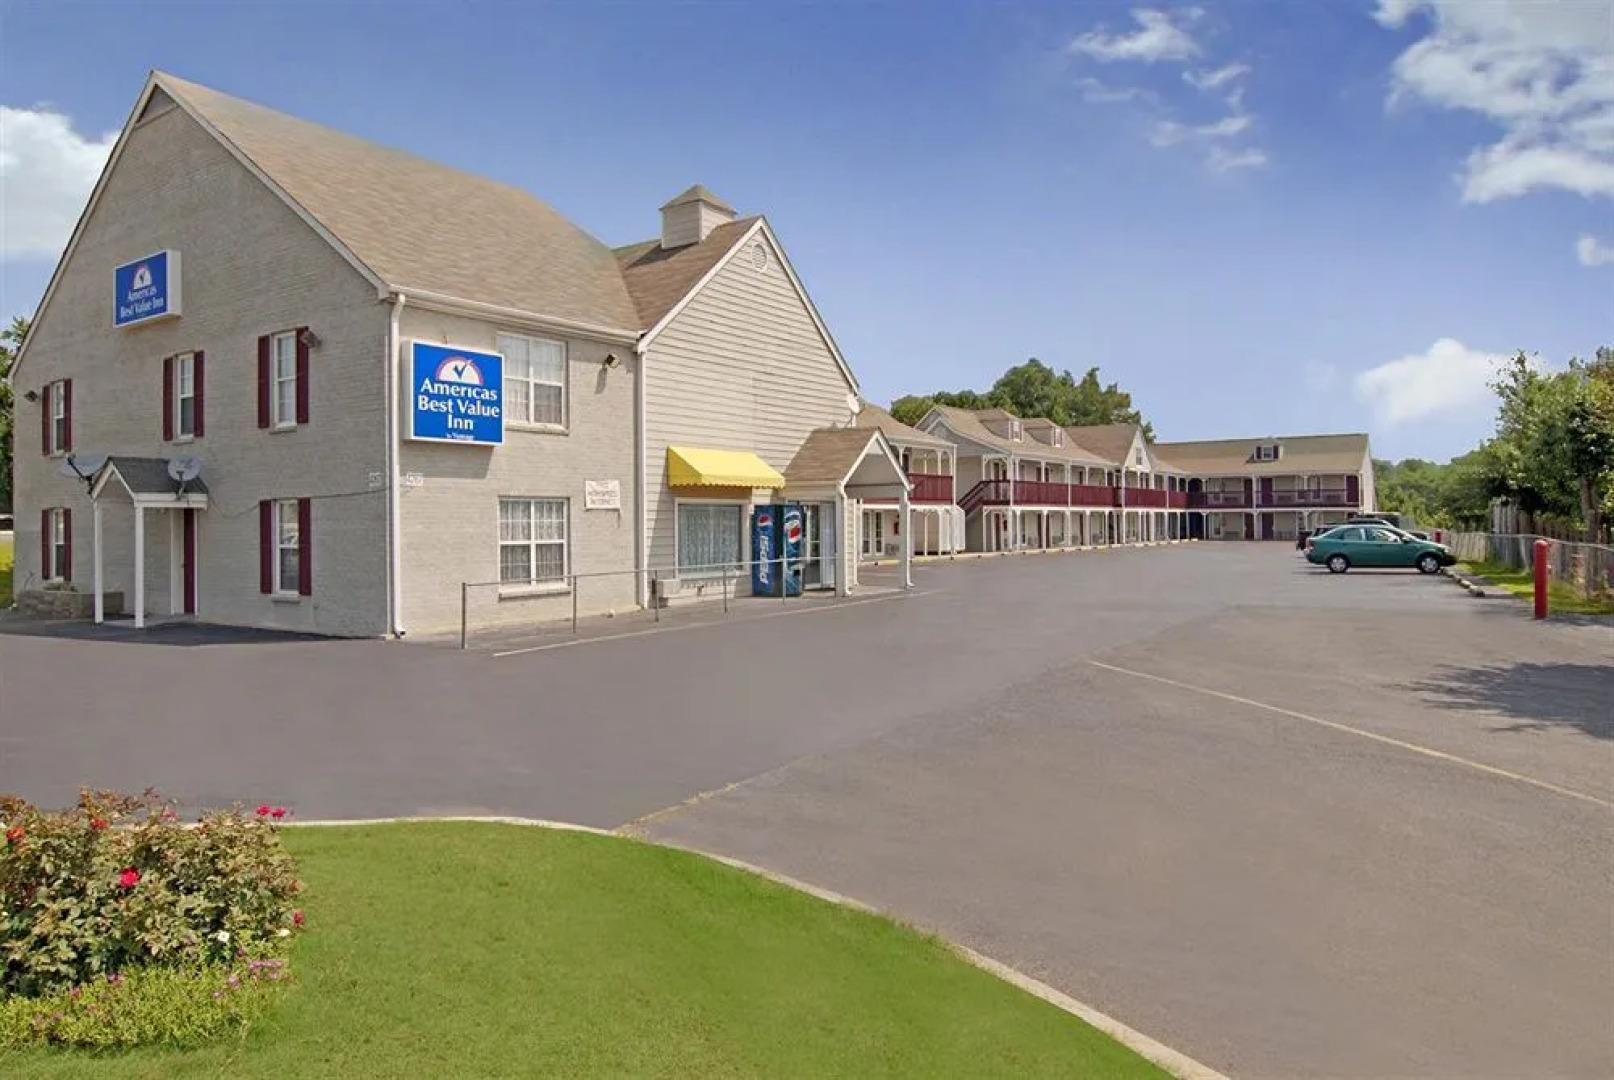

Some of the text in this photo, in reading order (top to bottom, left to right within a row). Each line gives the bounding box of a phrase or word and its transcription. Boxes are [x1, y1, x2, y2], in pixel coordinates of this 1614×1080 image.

[128, 286, 157, 302] Americas
[120, 296, 164, 318] Best Value Inn
[420, 377, 498, 401] Americas
[418, 395, 500, 418] Best Value
[447, 414, 474, 430] Inn
